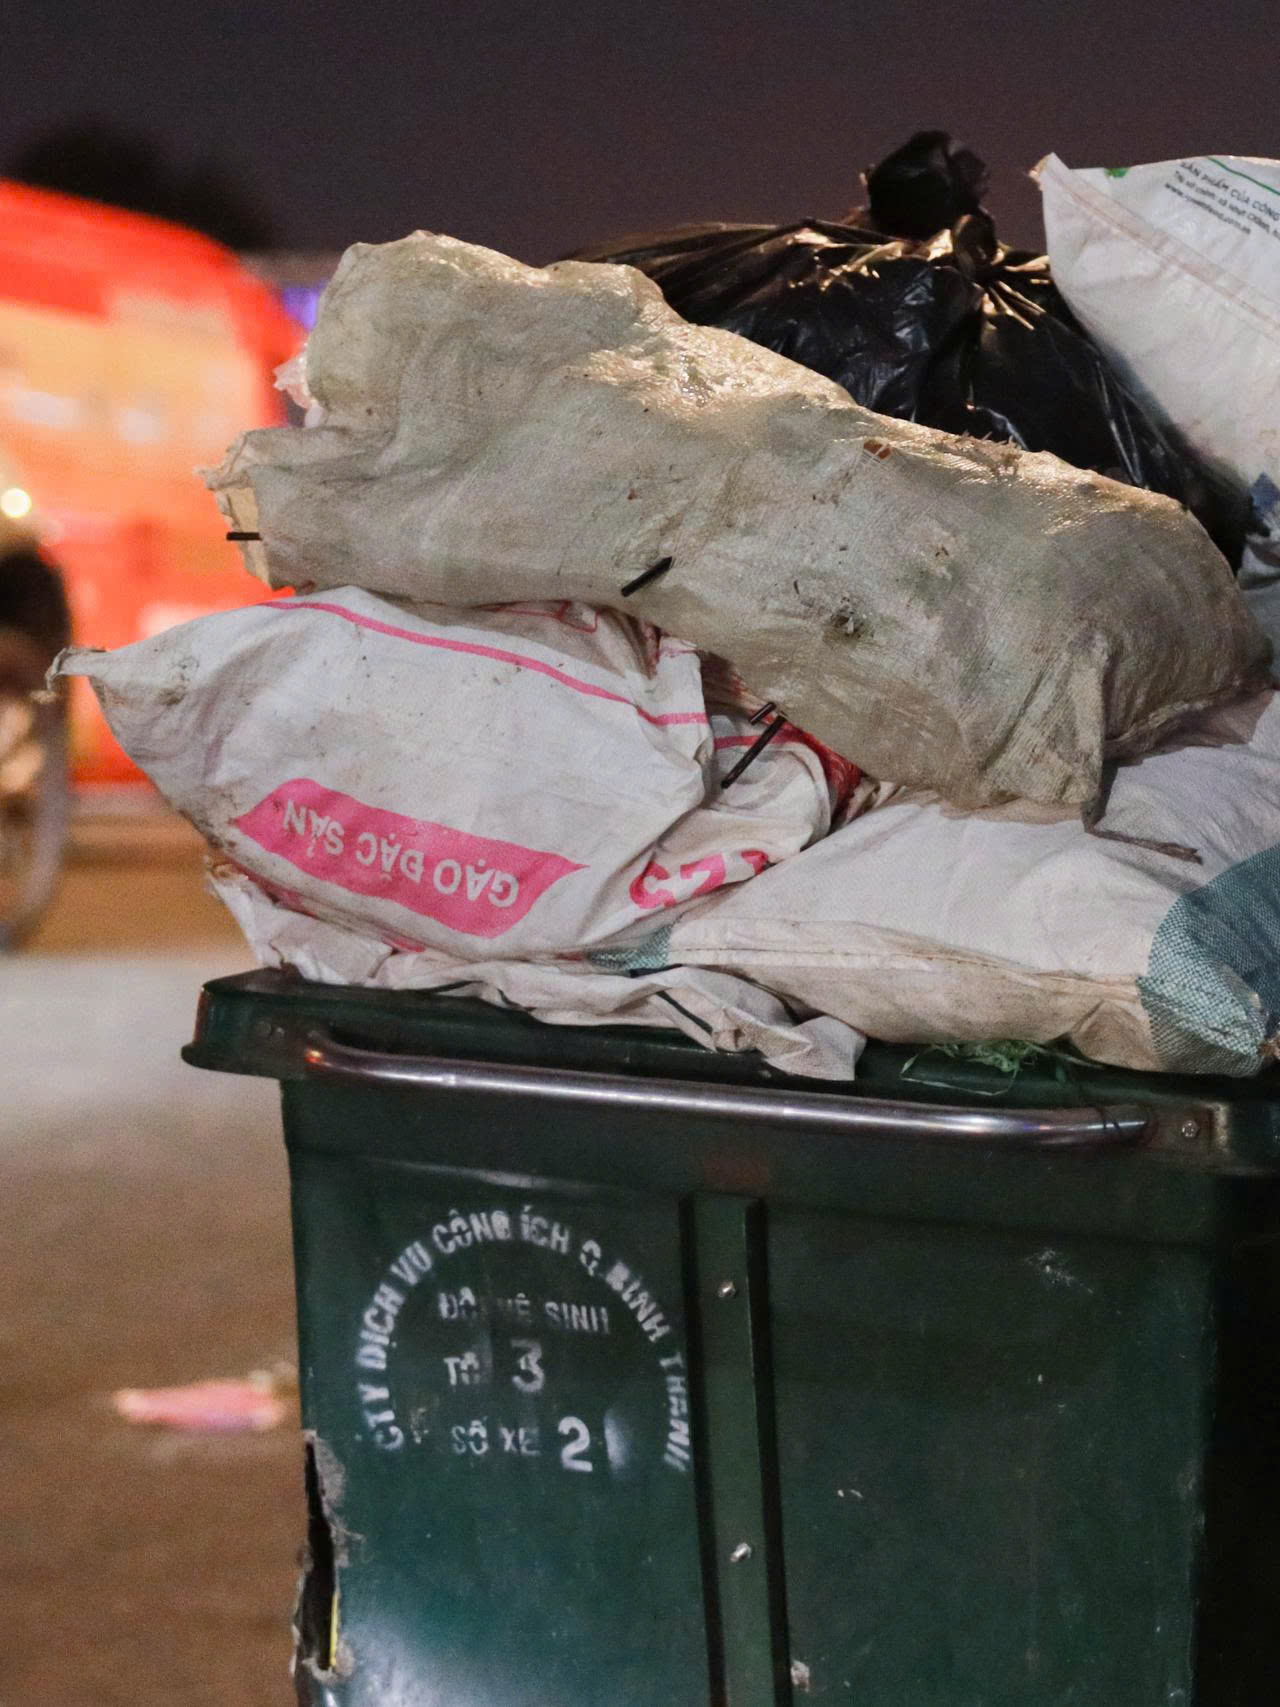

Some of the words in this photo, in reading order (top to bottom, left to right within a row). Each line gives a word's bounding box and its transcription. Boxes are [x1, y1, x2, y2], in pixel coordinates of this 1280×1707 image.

[283, 799, 345, 858] SẢN
[355, 831, 425, 884] ĐẶC
[432, 858, 519, 908] GẠO
[520, 1204, 570, 1255] ÍCH
[510, 1338, 546, 1393] 3
[499, 1425, 542, 1457] XE
[557, 1415, 593, 1473] 2
